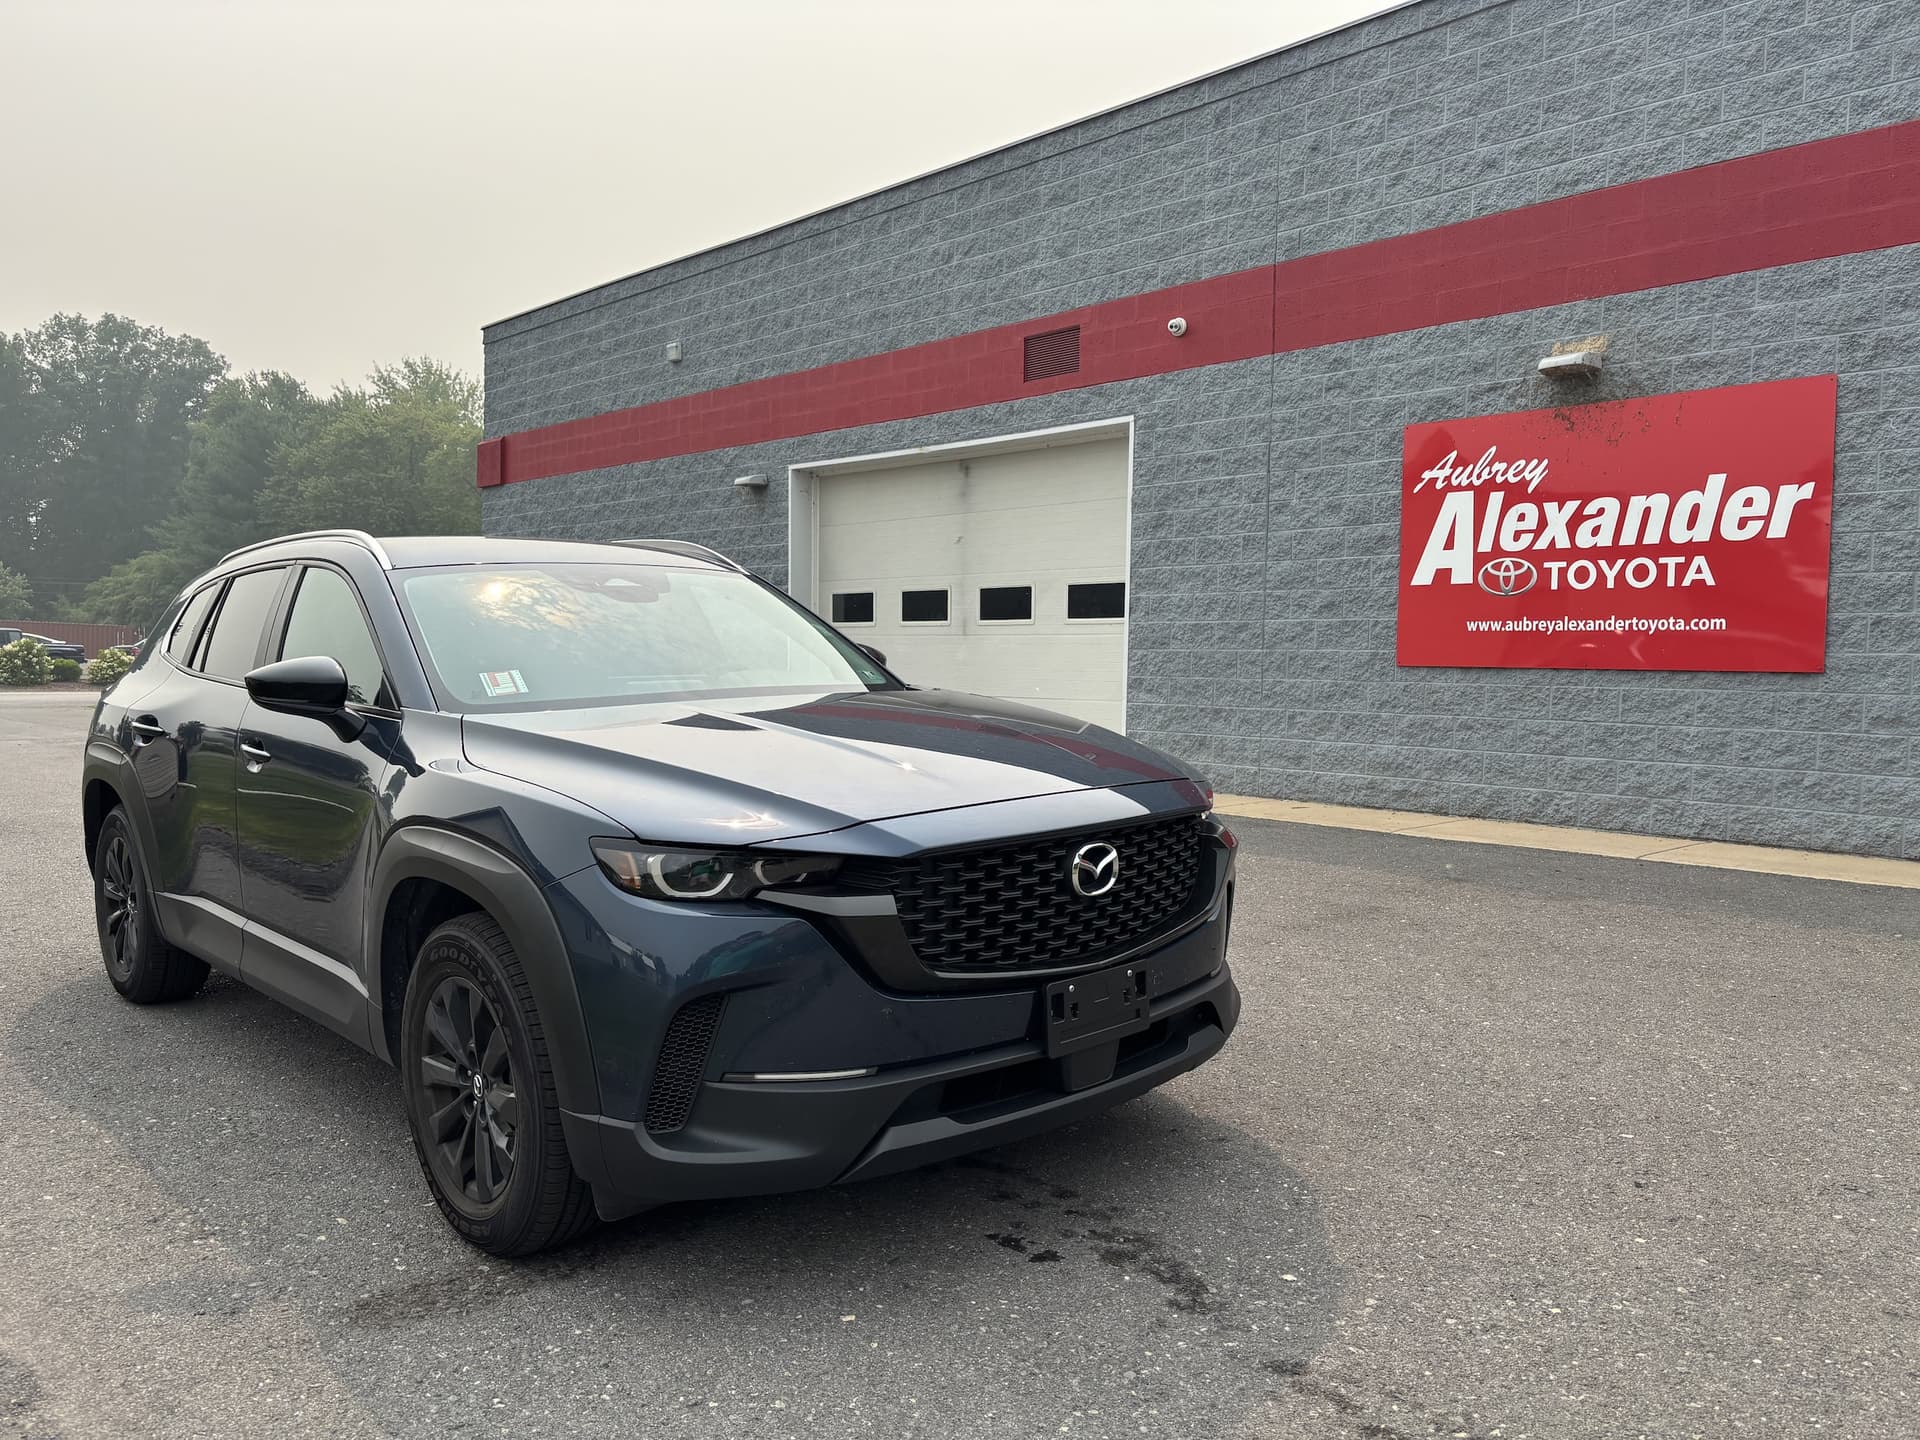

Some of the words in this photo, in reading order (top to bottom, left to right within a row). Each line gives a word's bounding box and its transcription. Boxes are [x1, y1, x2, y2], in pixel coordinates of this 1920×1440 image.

[1412, 445, 1549, 494] Aubrey
[1409, 472, 1816, 586] Alexander
[1543, 555, 1716, 591] TOYOTA
[1466, 614, 1727, 636] www.aubreyalexandertoyota.com
